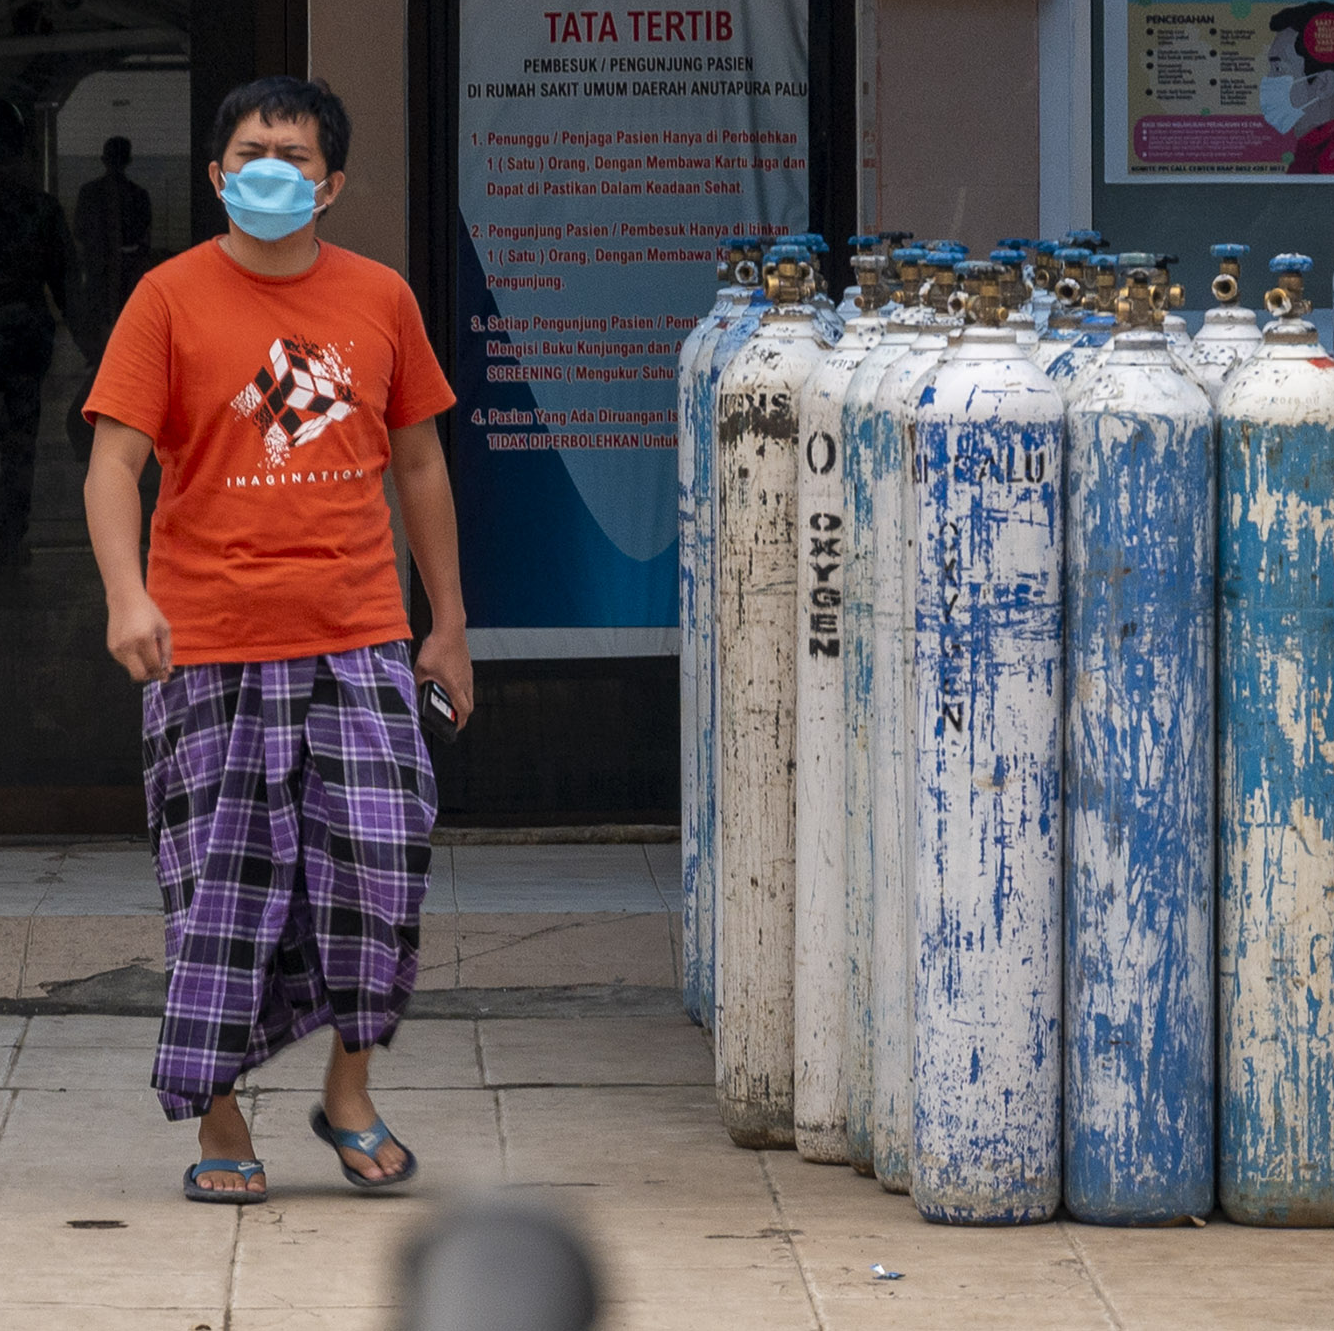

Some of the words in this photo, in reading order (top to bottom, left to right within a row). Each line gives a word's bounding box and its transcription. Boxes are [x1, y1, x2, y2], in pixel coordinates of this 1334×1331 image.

[545, 11, 617, 43] TATA
[628, 10, 733, 42] TERTIB
[1146, 15, 1214, 24] PENCEGAHAN
[524, 58, 597, 73] PEMBESUK
[610, 58, 702, 72] PENGUNJUNG
[707, 57, 753, 71] PASIEN
[467, 84, 481, 98] DI
[486, 83, 535, 98] RUMAH
[541, 83, 578, 97] SAKIT
[583, 82, 628, 96] UMUM
[633, 82, 686, 96] DAERAH
[691, 81, 771, 96] ANUTAPURA
[775, 82, 807, 97] PALU
[472, 133, 482, 145] 1.
[488, 132, 549, 148] Penunggu
[562, 131, 612, 148] Penjaga
[617, 131, 658, 145] Pasien
[663, 131, 702, 147] Hanya
[706, 130, 718, 144] di
[723, 130, 797, 144] Perbolehkan
[487, 158, 494, 171] 1
[507, 158, 535, 171] Satu
[595, 157, 642, 173] Dengan
[647, 156, 711, 169] Membawa
[715, 155, 747, 169] Kartu
[752, 155, 779, 172] Jaga
[783, 155, 805, 169] dan
[487, 183, 523, 198] Dapat
[527, 182, 539, 195] di
[543, 182, 596, 195] Pastikan
[601, 182, 641, 195] Dalam
[646, 181, 700, 194] Keadaan
[705, 180, 744, 194] Sehat.
[472, 226, 483, 239] 2.
[488, 225, 562, 240] Pengunjung
[567, 224, 608, 238] Pasien
[621, 223, 685, 237] Pembesuk
[690, 223, 728, 239] Hanya
[733, 223, 744, 235] di
[749, 222, 789, 235] Izinkan
[487, 275, 565, 291] Pengunjung.
[487, 435, 527, 450] TIDAK
[530, 434, 639, 449] DIPERBOLEHKAN
[226, 469, 363, 487] IMAGINATION
[810, 514, 842, 658] OXYGEN
